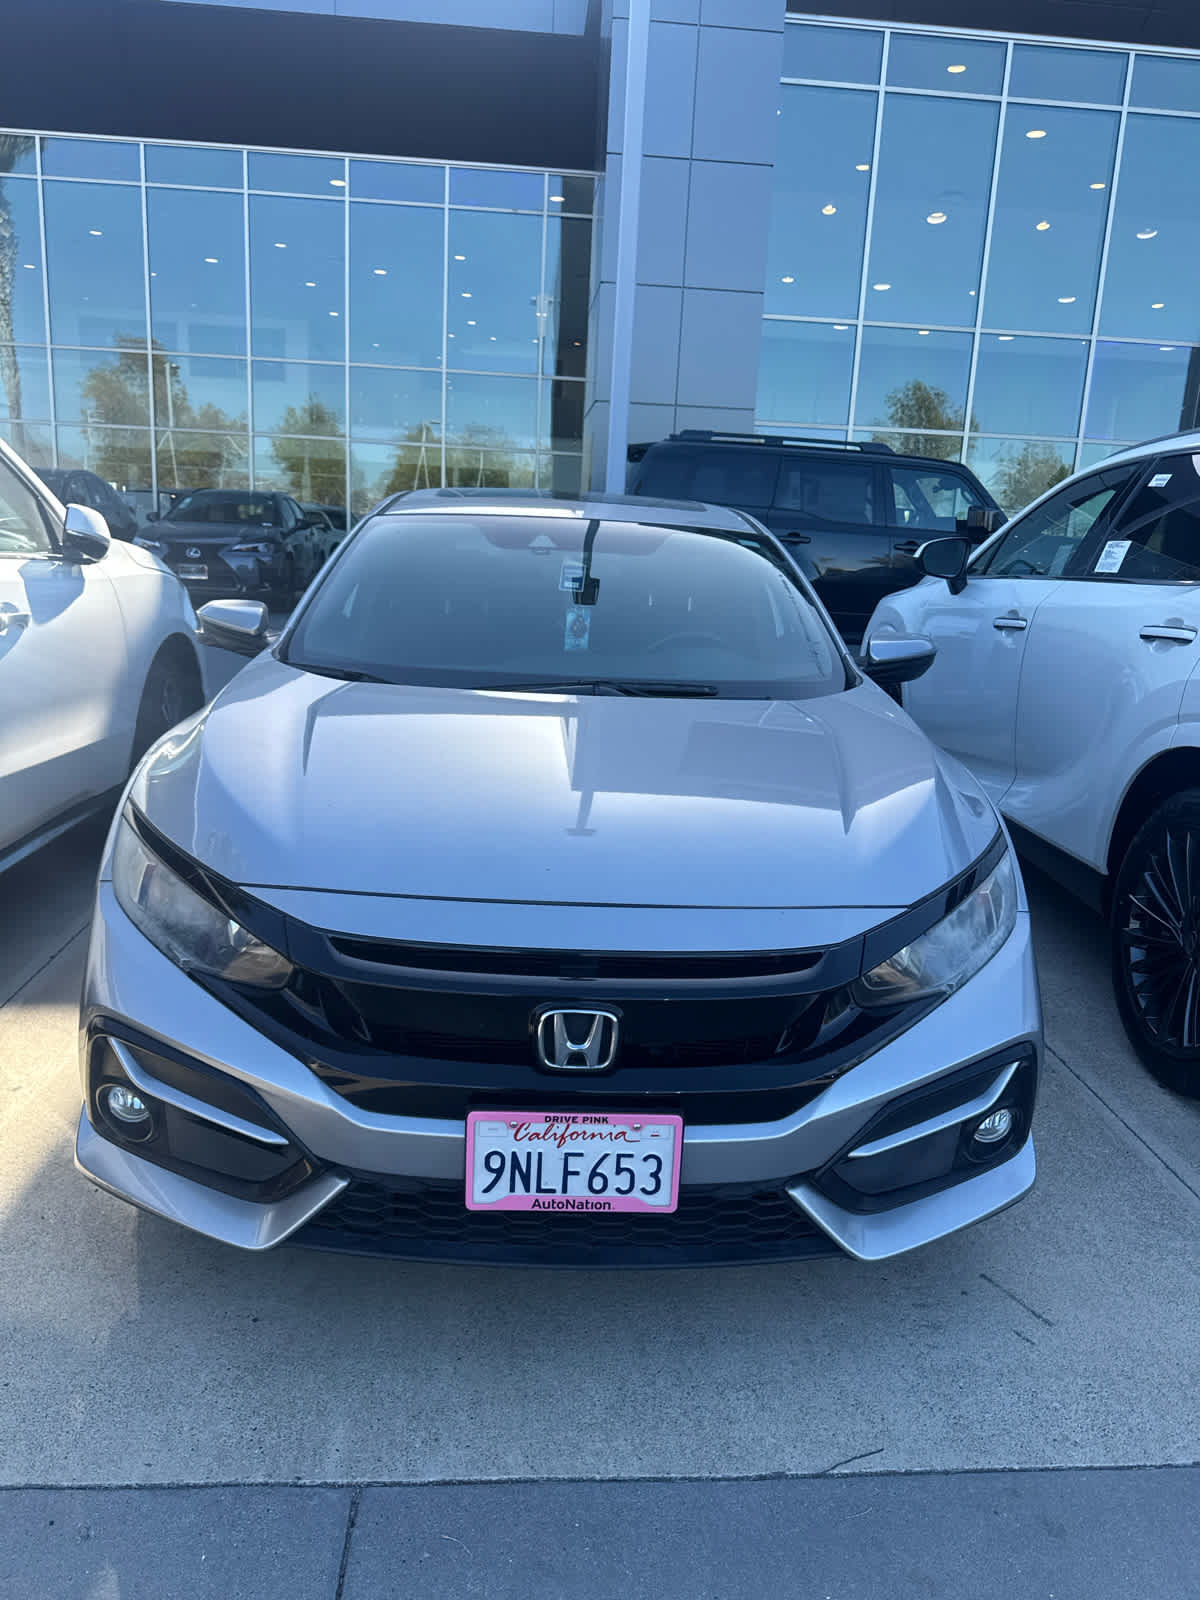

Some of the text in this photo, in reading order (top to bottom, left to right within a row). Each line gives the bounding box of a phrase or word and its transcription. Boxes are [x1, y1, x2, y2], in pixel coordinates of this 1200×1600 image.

[544, 1115, 609, 1125] DRIVE PINK
[513, 1122, 641, 1148] California
[482, 1150, 663, 1195] 9NLF653
[531, 1198, 612, 1211] AutoNation
